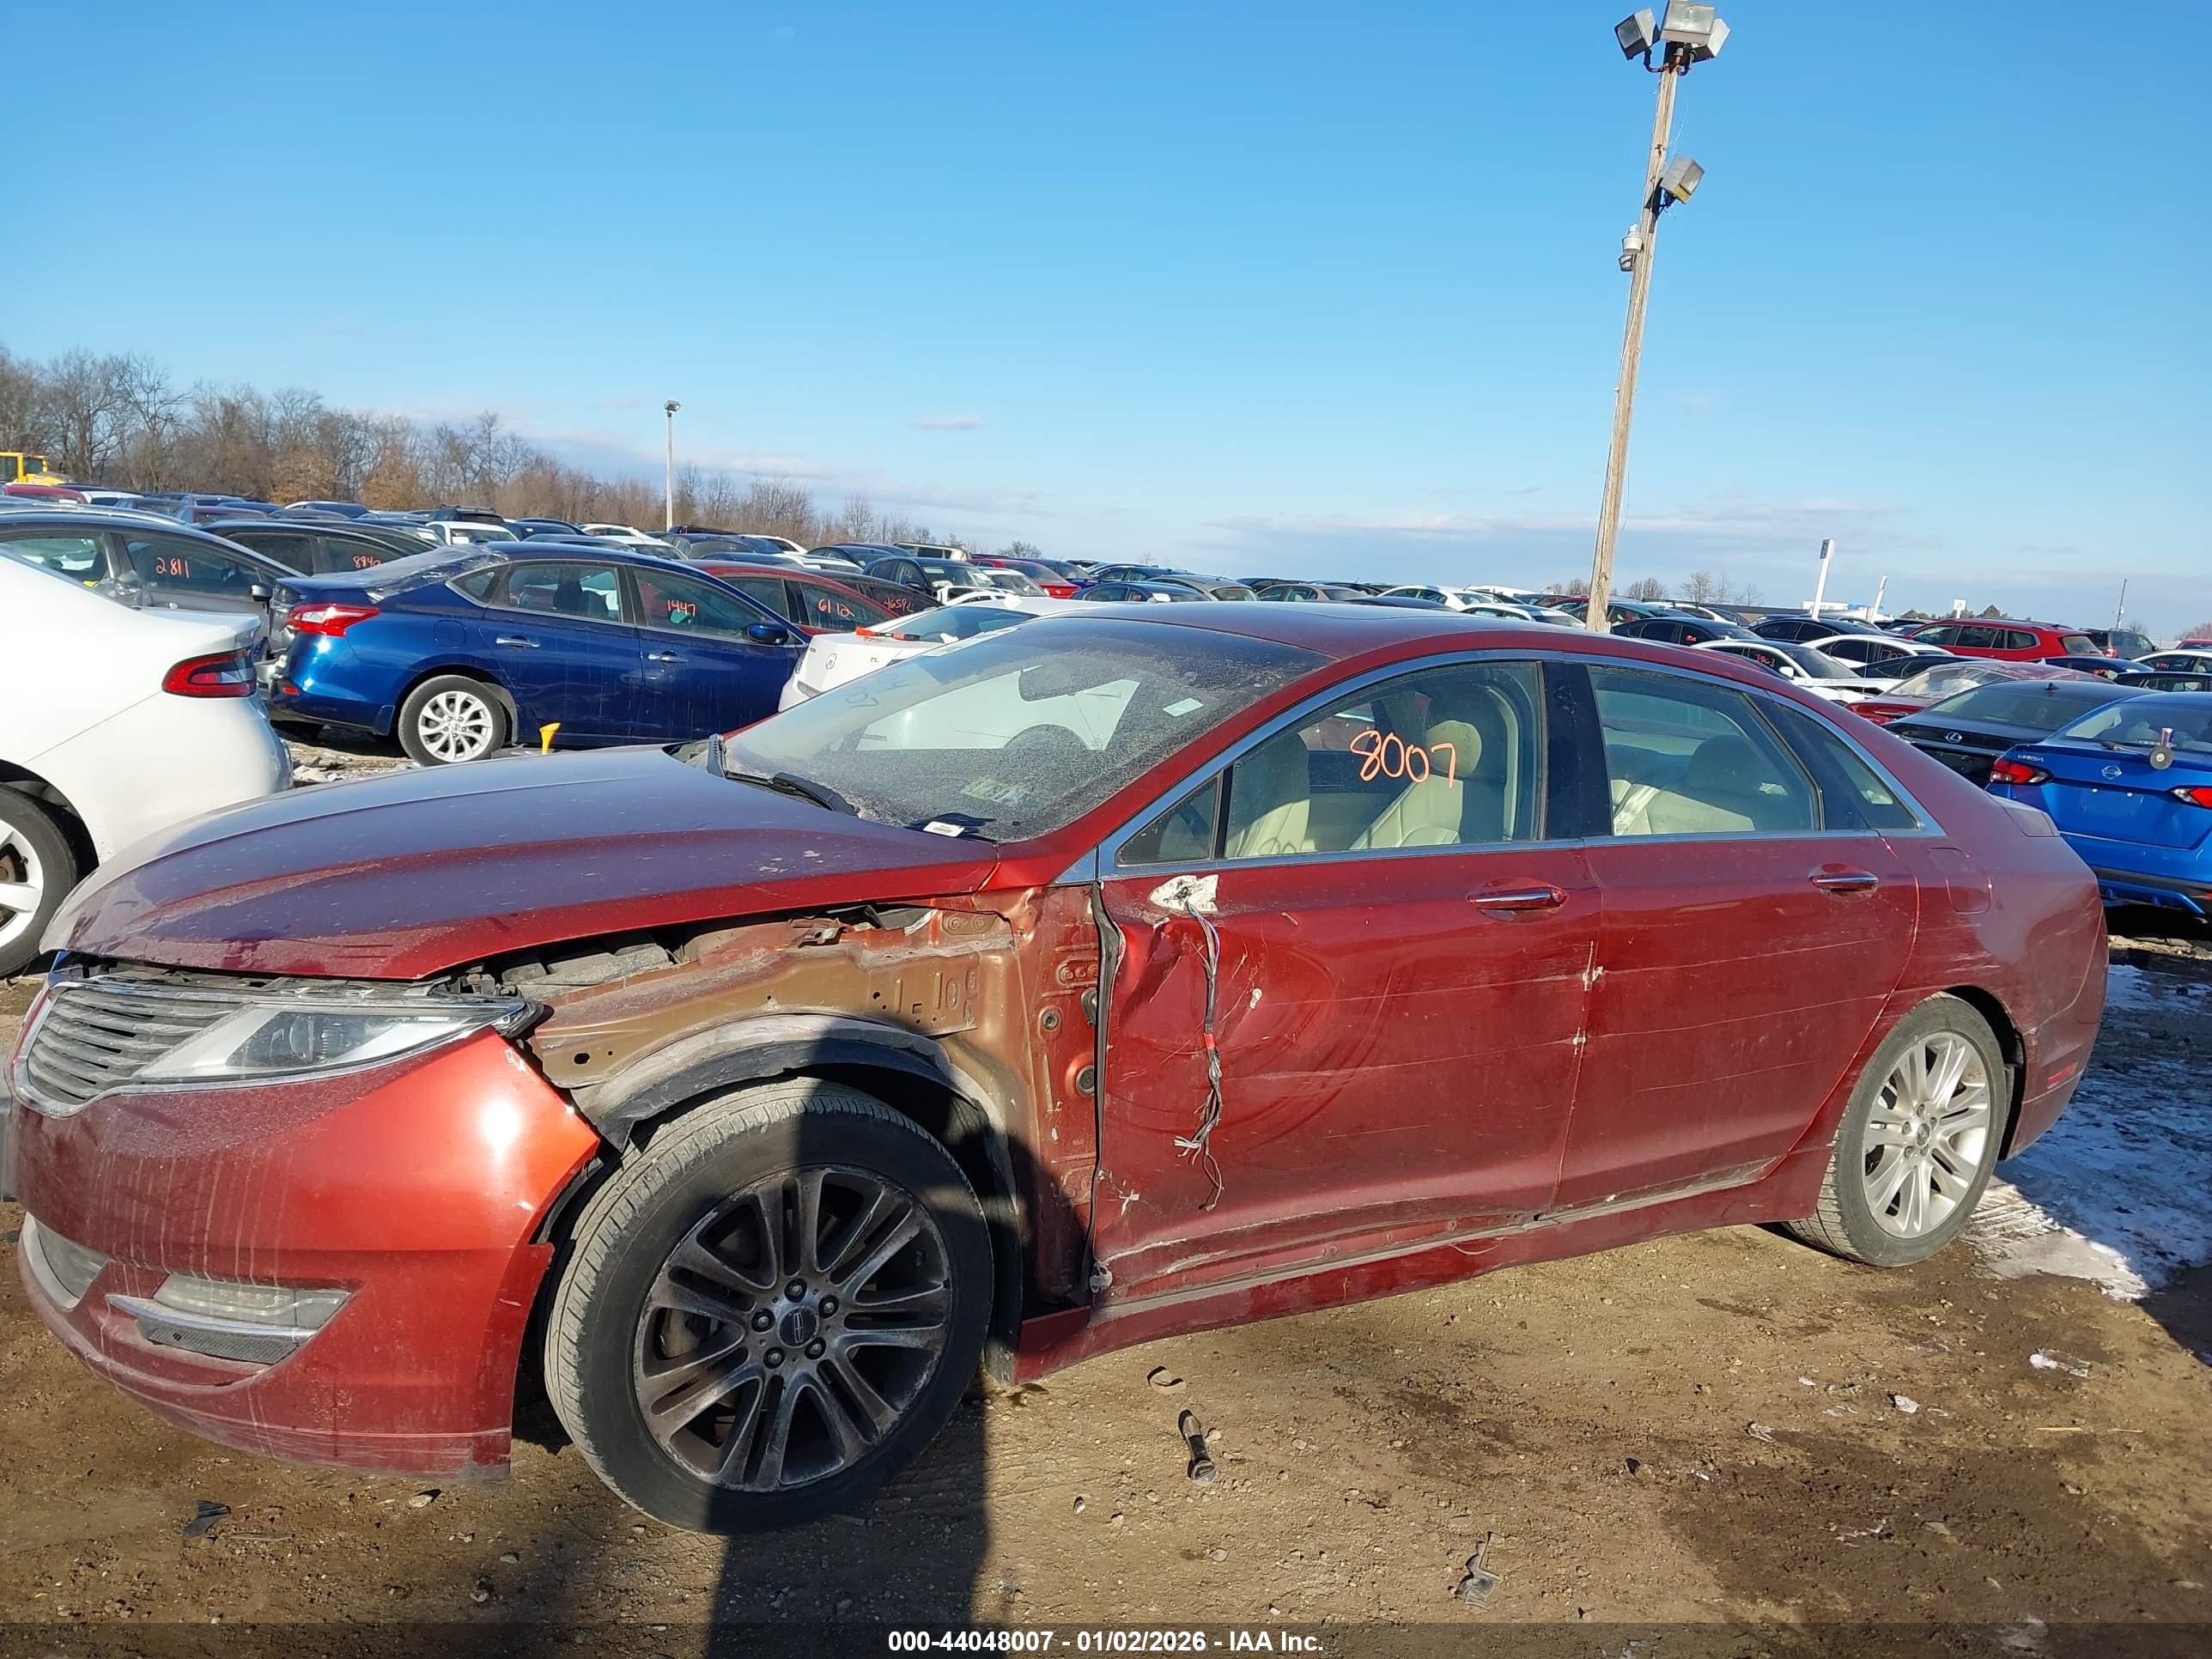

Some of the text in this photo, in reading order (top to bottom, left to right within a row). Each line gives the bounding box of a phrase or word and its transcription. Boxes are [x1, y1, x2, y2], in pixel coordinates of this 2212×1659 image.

[155, 556, 190, 579] 2811
[667, 599, 696, 617] 1447
[1350, 730, 1456, 789] 8007
